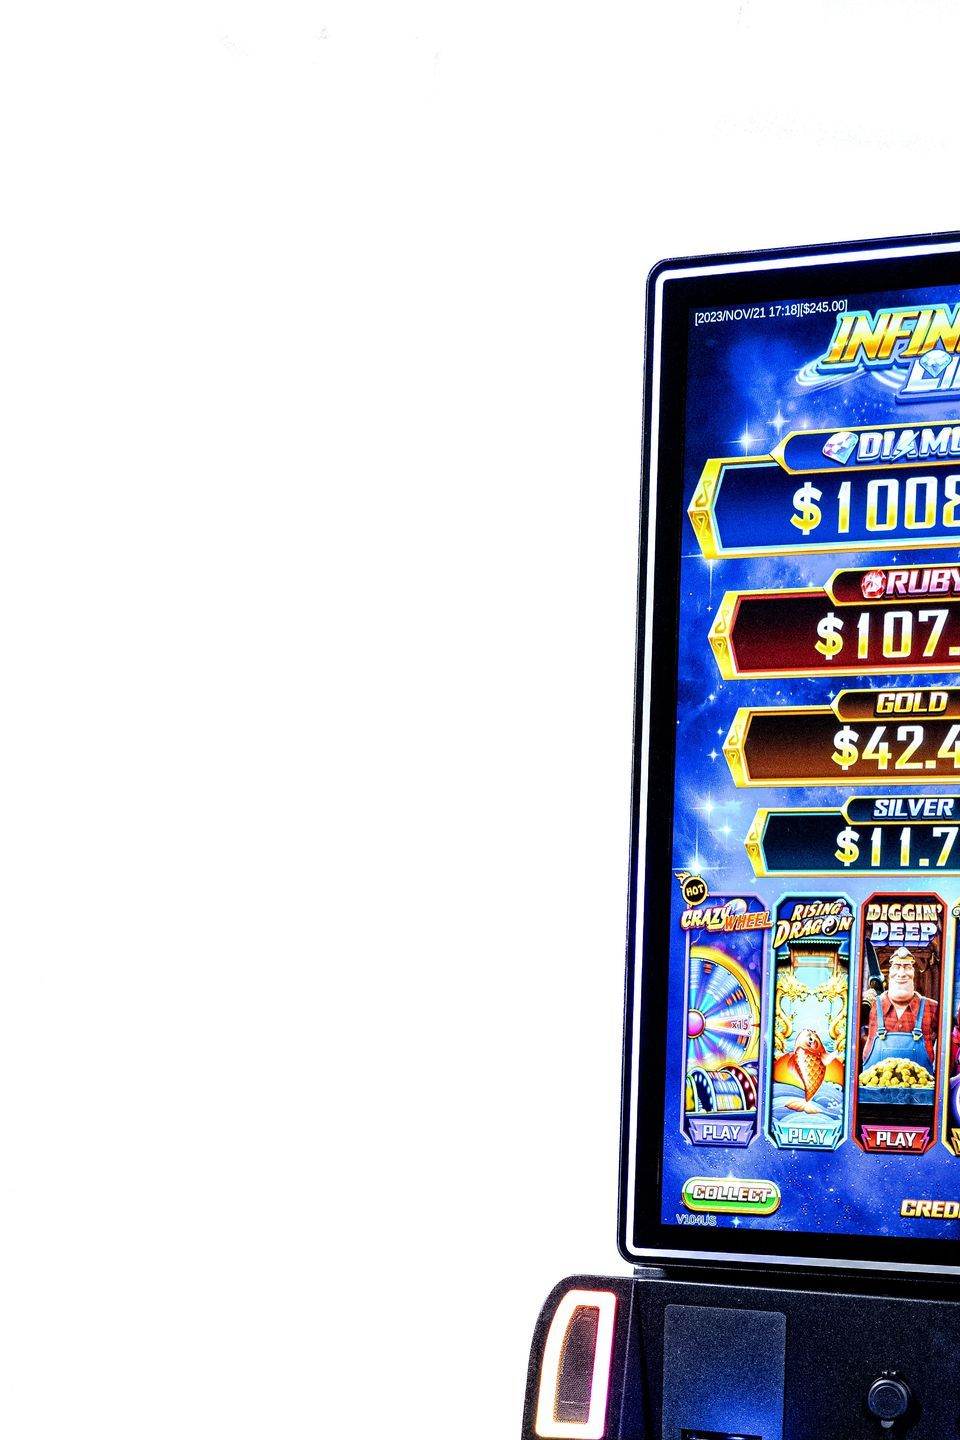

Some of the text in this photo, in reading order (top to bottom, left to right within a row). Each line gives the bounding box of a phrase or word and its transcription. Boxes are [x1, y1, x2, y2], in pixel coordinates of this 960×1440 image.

[694, 299, 848, 326] [2023/NOV/21 17:18][$245.00]
[876, 692, 949, 713] GOLD
[873, 799, 954, 818] SILVER
[686, 884, 704, 896] HOT
[681, 905, 774, 932] CRAZY WHEEL
[791, 902, 842, 921] RISING
[866, 903, 942, 921] DIGGIN'
[773, 916, 853, 949] DRAGON
[871, 922, 938, 947] DEEP
[702, 1125, 741, 1141] PLAY
[788, 1128, 828, 1145] PLAY
[876, 1131, 916, 1148] PLAY
[692, 1185, 773, 1203] COLLECT
[676, 1213, 717, 1226] V104US
